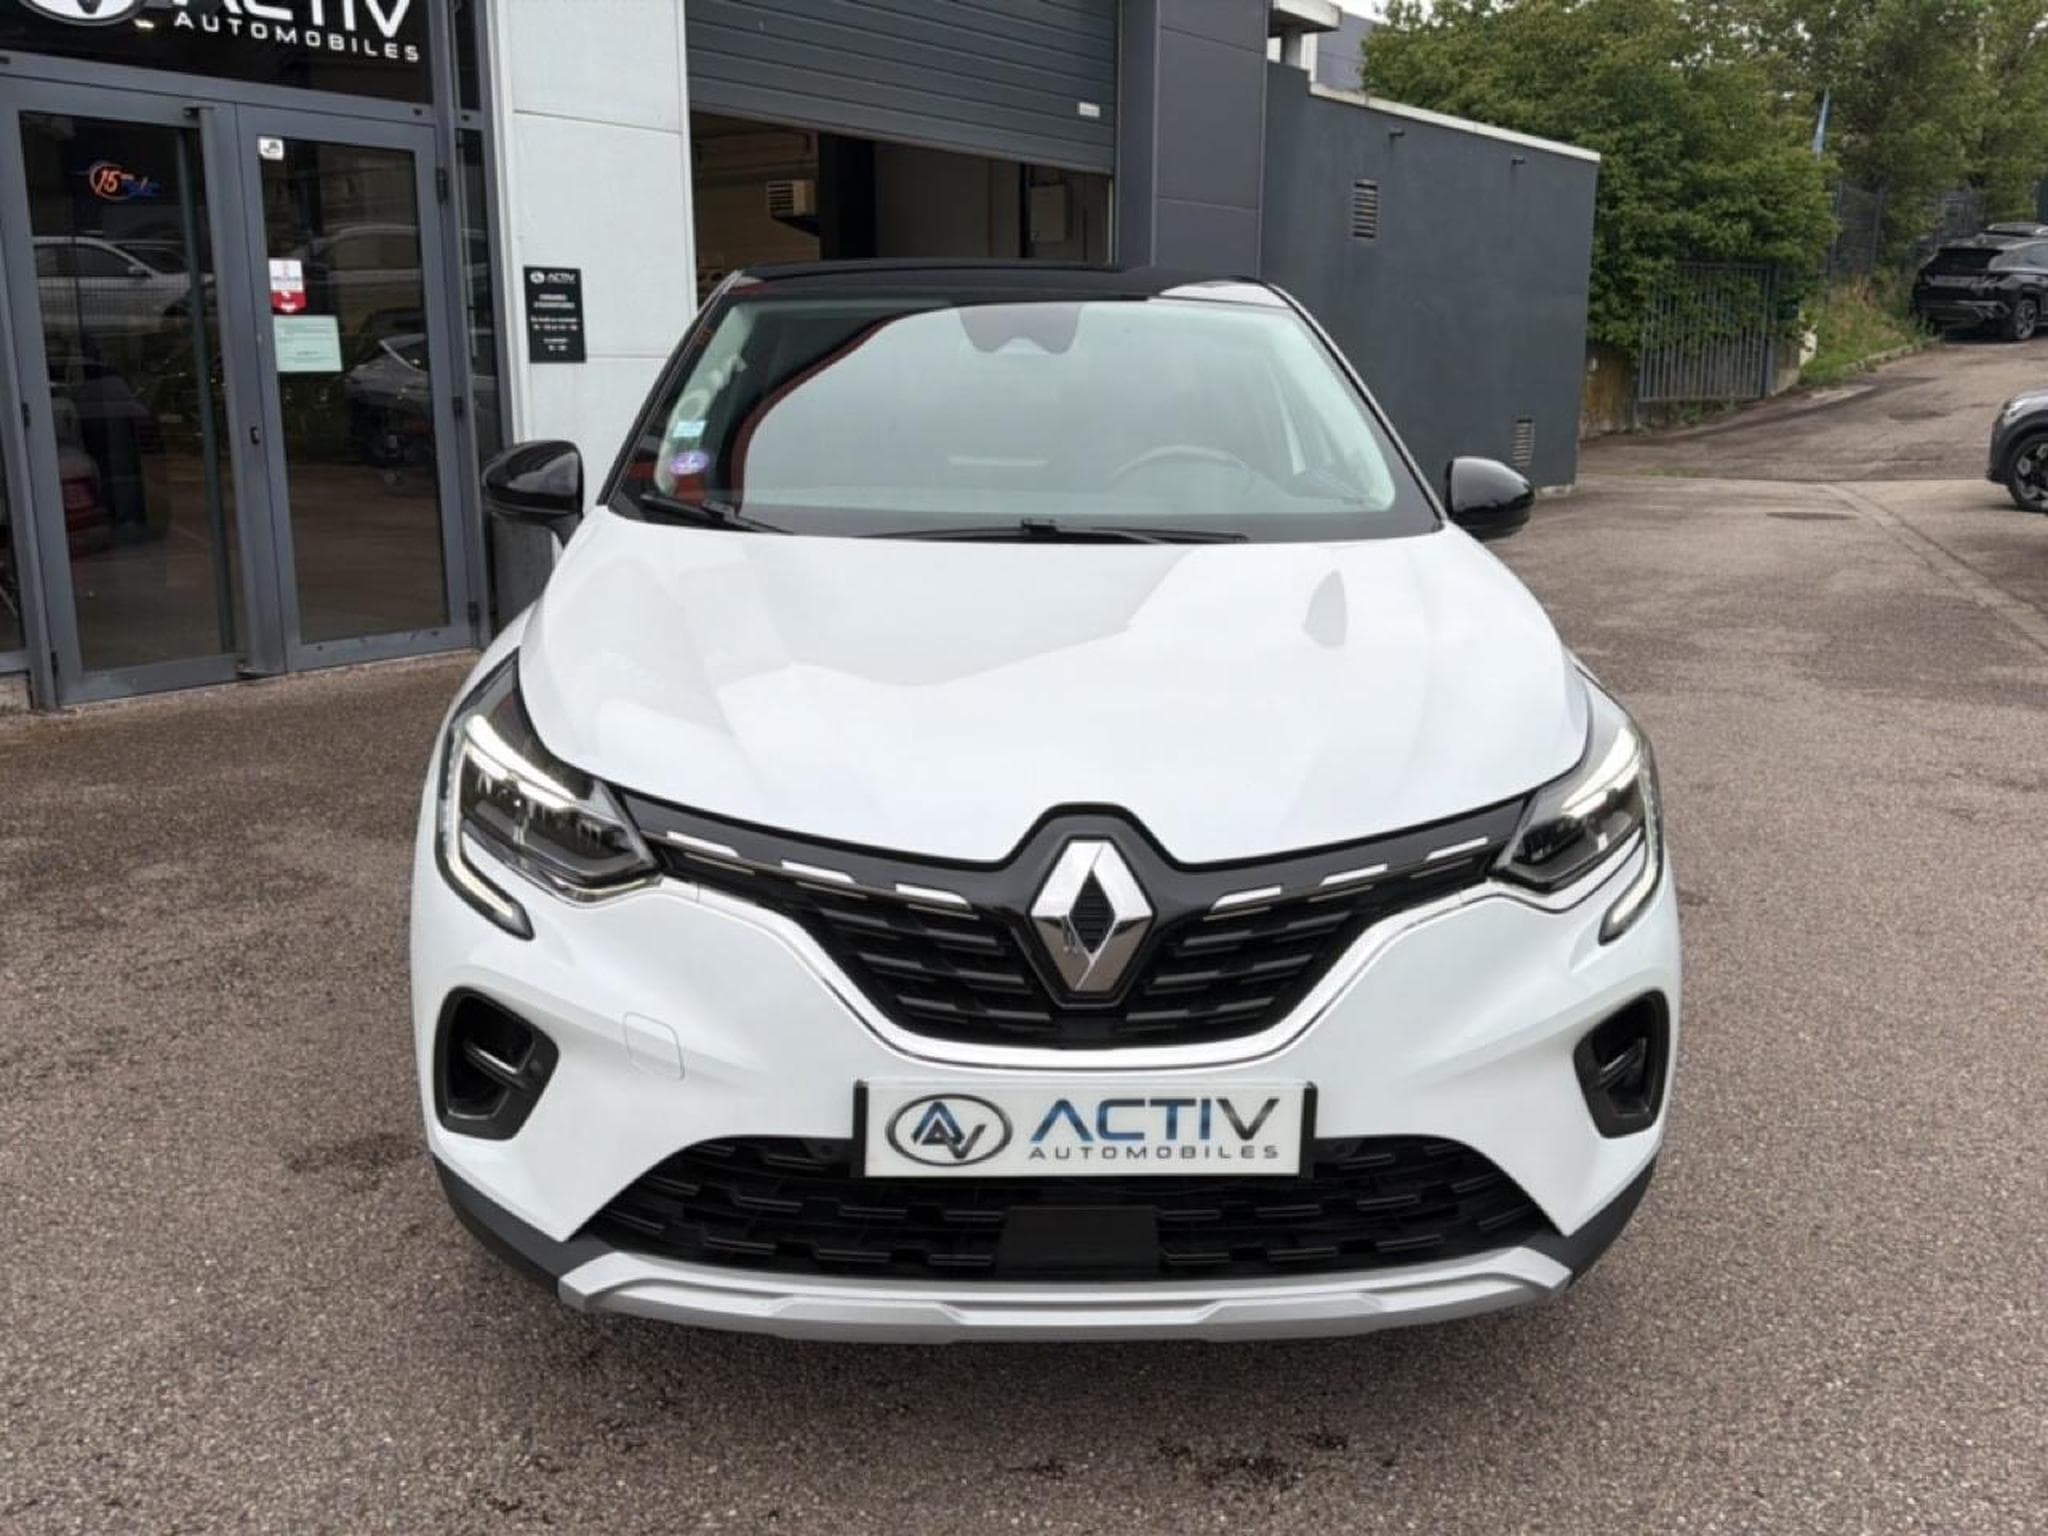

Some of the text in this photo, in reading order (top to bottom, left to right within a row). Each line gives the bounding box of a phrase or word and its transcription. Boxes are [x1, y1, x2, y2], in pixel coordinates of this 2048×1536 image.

[172, 0, 410, 38] TIV
[173, 11, 419, 62] AUTOMOBILES
[1031, 1098, 1280, 1141] ACTIV
[1029, 1145, 1279, 1159] AUTOMOBILES
